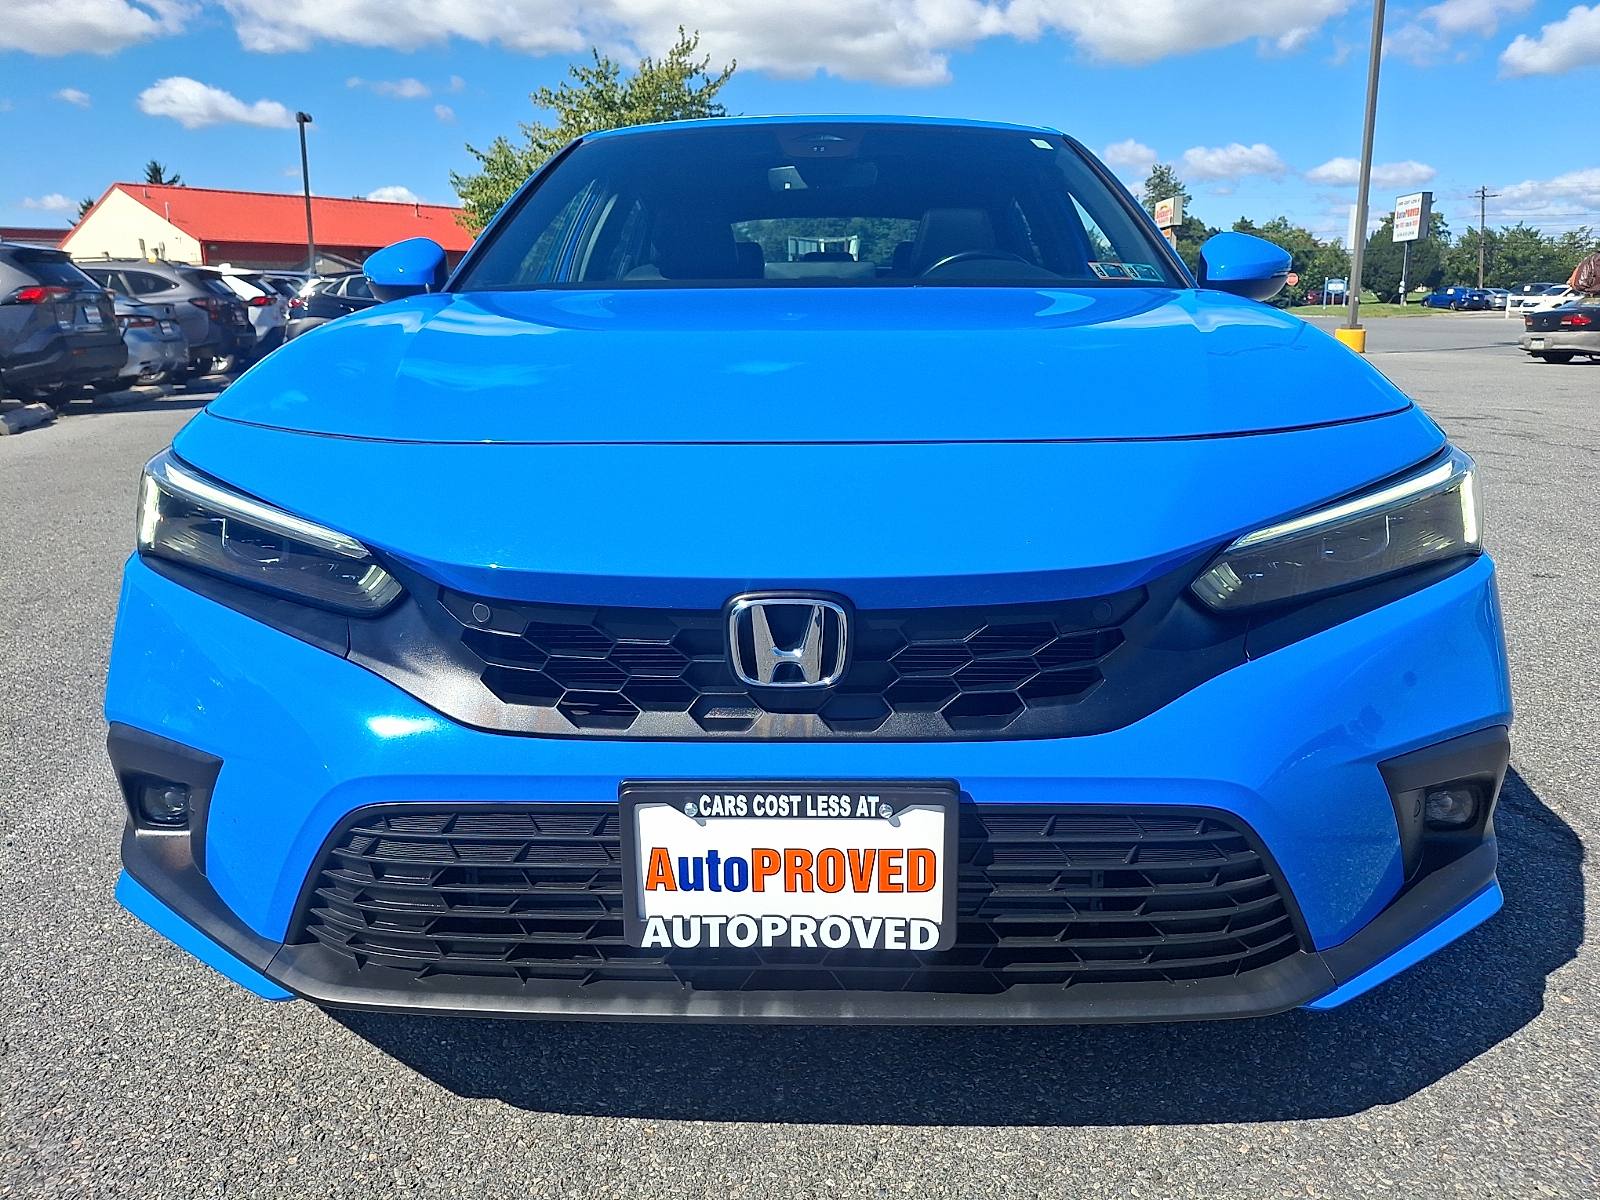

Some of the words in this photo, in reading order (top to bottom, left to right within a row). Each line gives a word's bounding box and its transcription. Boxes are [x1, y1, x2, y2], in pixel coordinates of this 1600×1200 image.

[699, 794, 748, 817] CARS
[752, 794, 802, 817] COST
[806, 794, 851, 817] LESS
[855, 795, 880, 817] AT
[645, 847, 937, 893] AutoPROVED
[641, 914, 940, 951] AUTOPROVED
